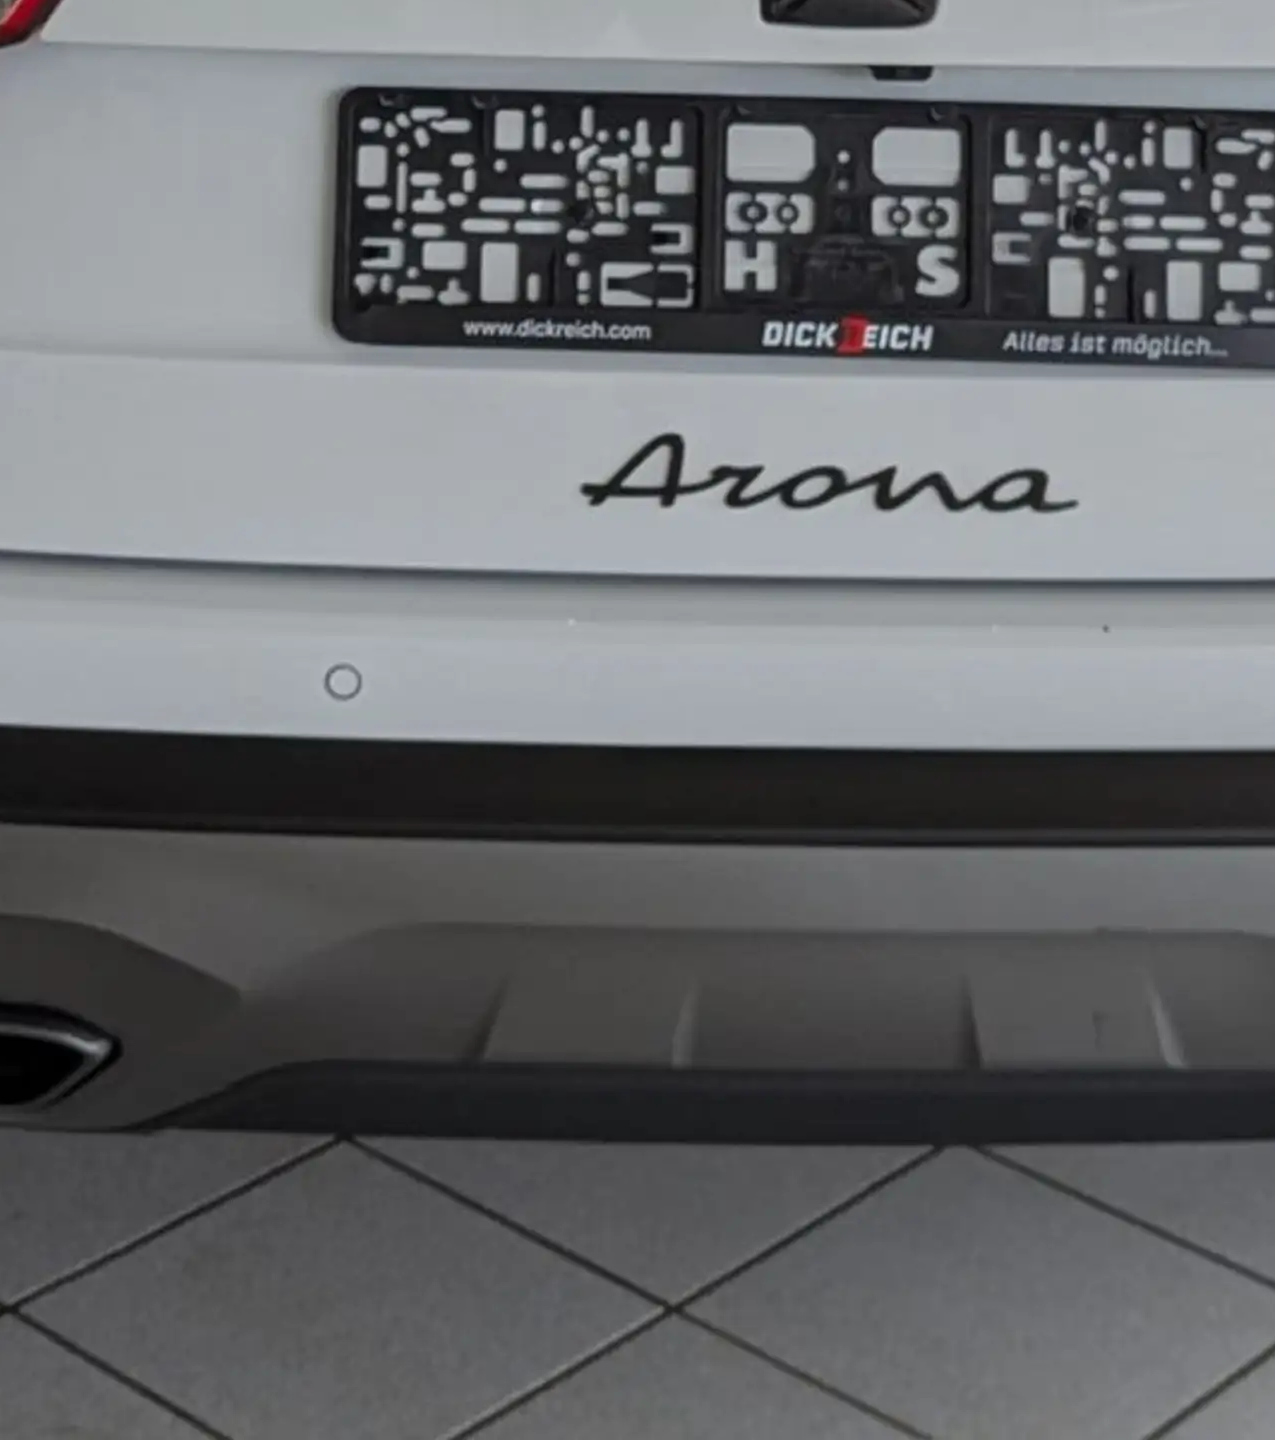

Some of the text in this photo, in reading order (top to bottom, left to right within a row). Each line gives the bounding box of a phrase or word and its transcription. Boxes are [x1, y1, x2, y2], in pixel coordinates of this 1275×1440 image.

[462, 318, 651, 340] www.dickreich.com
[1002, 330, 1064, 352] Alles
[1069, 331, 1107, 354] ist
[580, 433, 1078, 512] Arona
